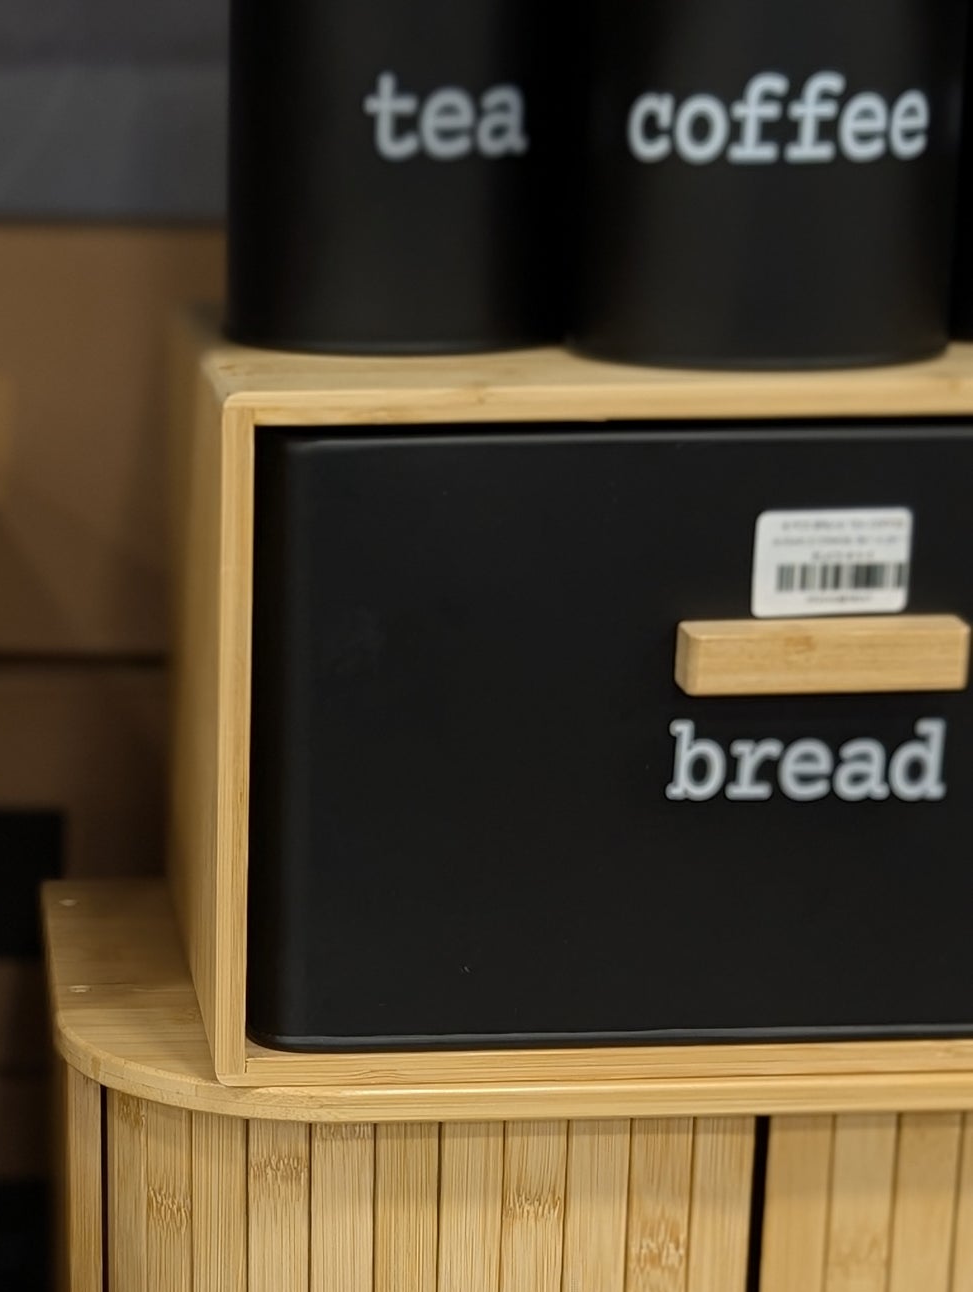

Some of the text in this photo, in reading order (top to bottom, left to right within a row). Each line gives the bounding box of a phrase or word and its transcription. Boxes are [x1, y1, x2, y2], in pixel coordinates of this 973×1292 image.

[364, 72, 526, 160] tea
[628, 71, 929, 164] coffee
[664, 718, 947, 802] bread
